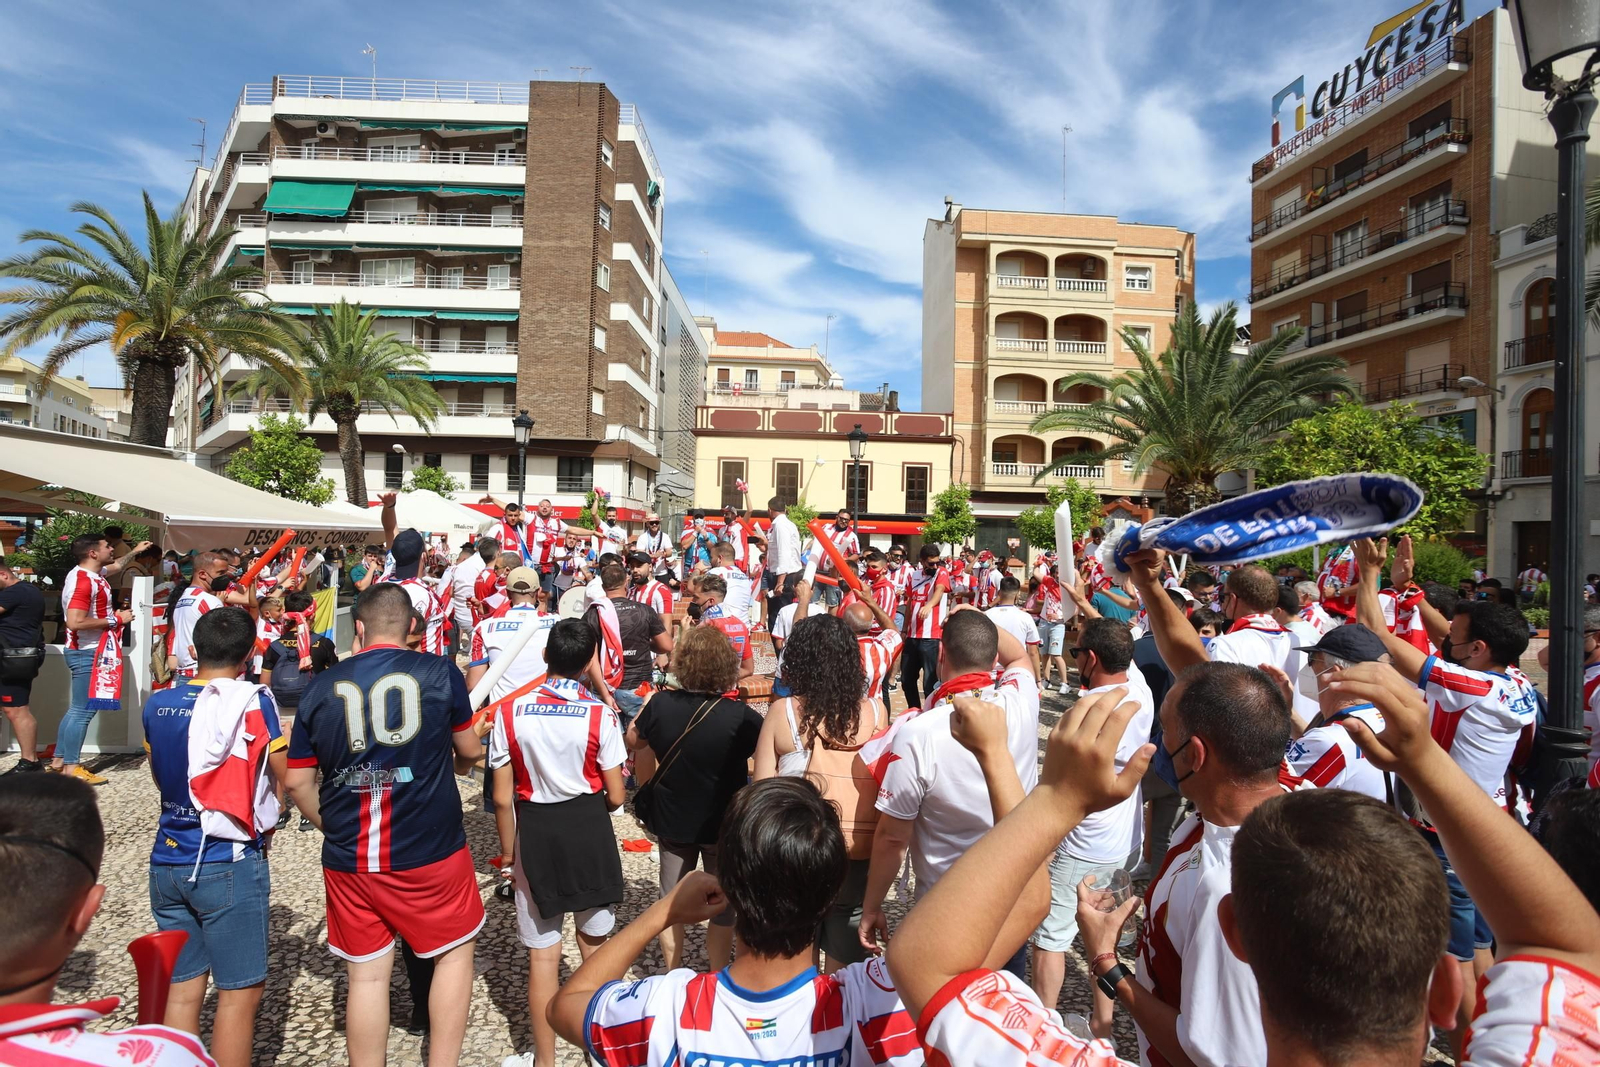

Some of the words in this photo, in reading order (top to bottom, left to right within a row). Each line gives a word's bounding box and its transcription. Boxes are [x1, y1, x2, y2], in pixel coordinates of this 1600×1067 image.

[1311, 0, 1465, 119] CUYCESA
[1351, 54, 1426, 114] METALICAS
[244, 530, 317, 546] DESANOS
[324, 532, 369, 544] COMIDAS
[157, 707, 178, 717] CITY
[333, 671, 422, 754] 10
[526, 704, 586, 715] STOP-FLUID
[332, 766, 414, 788] PIEDRA
